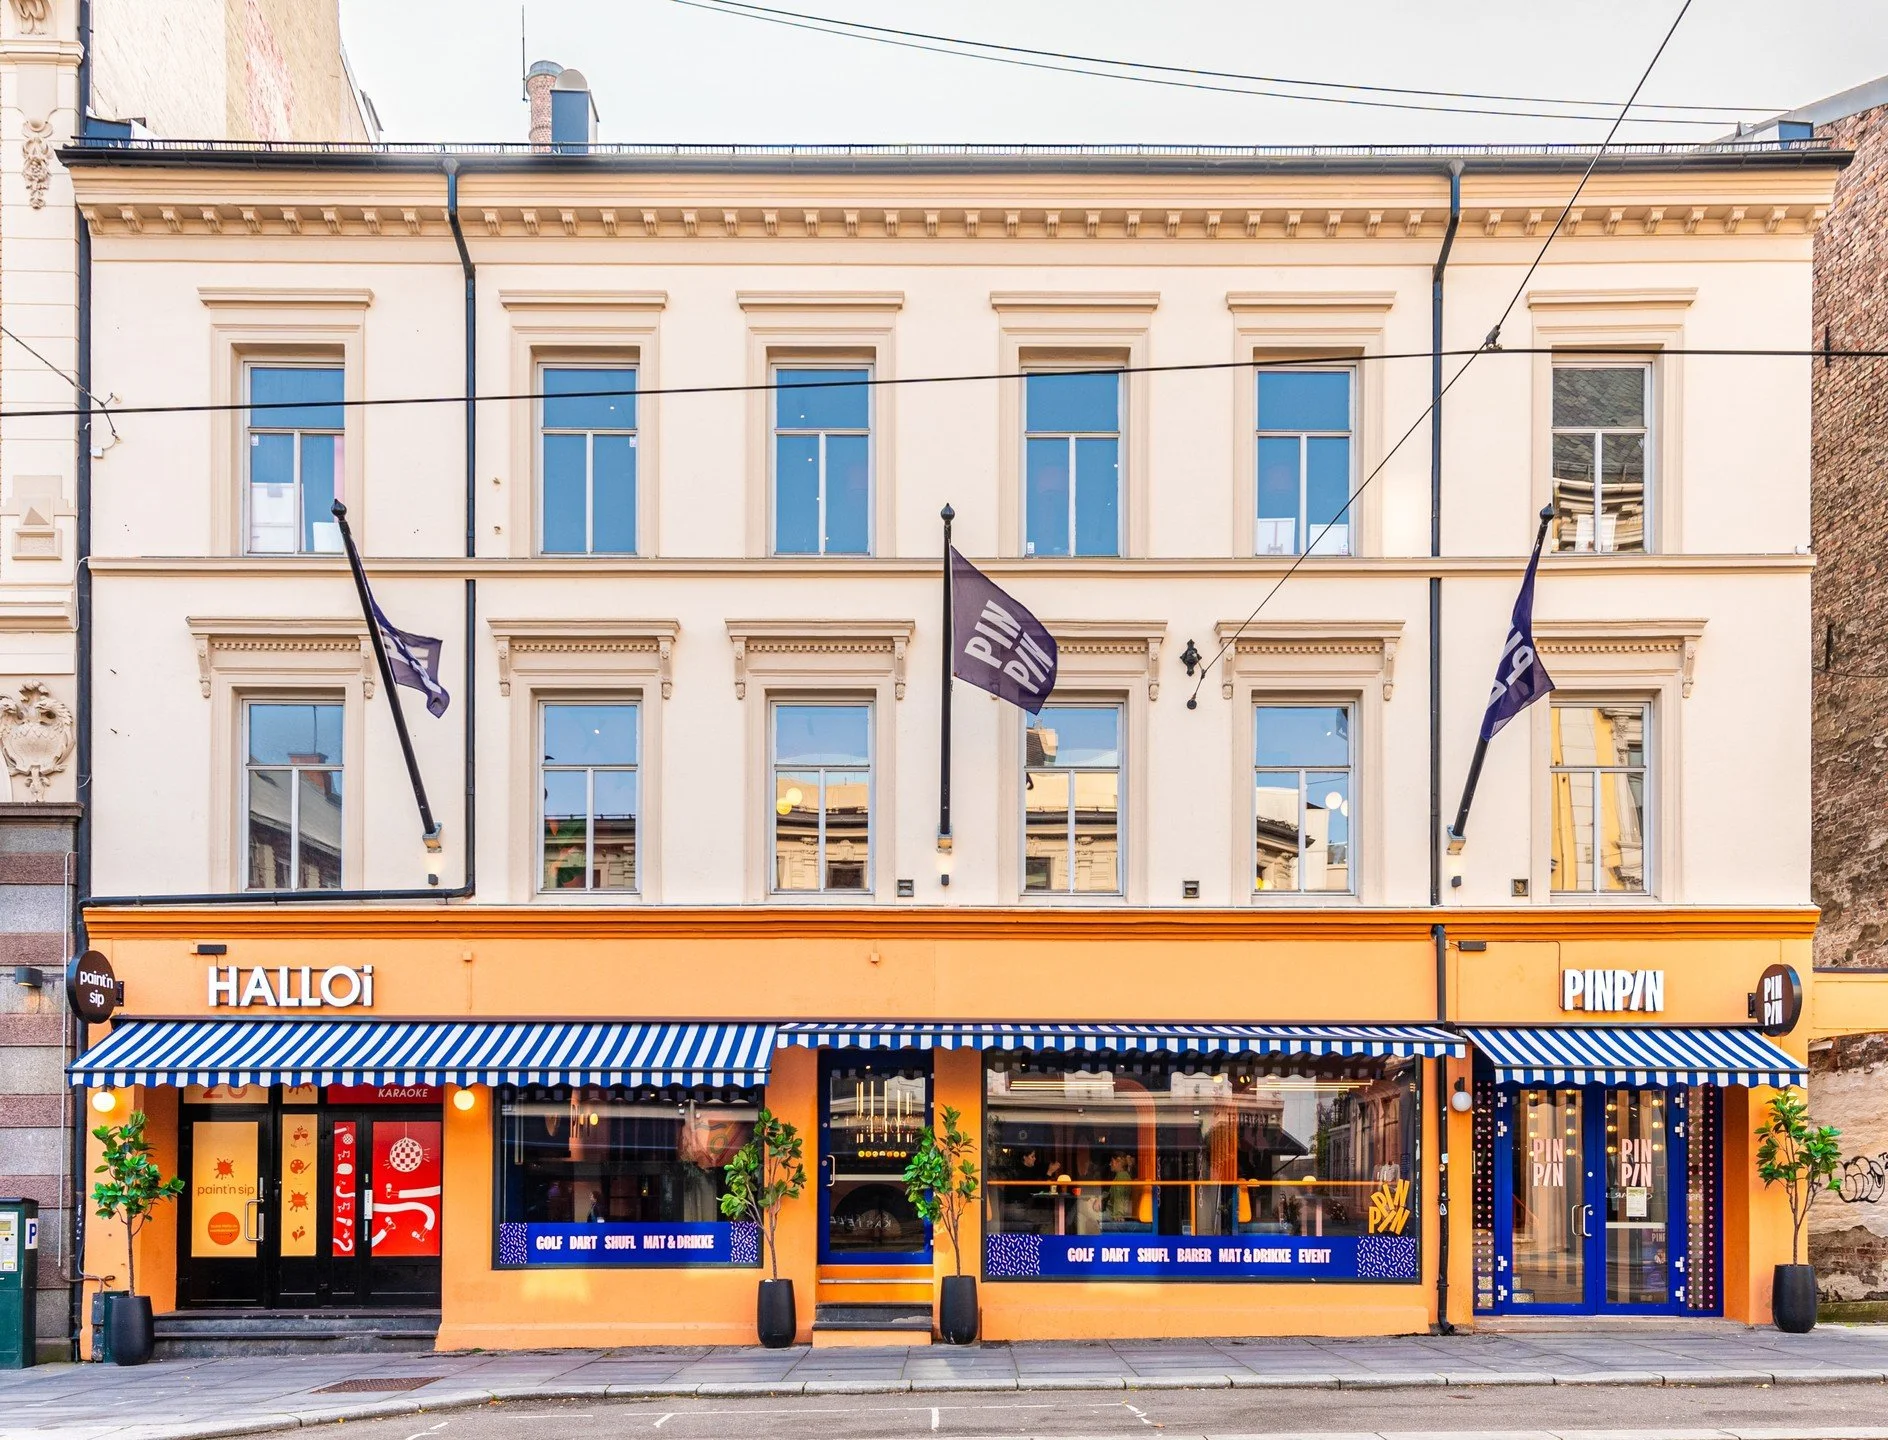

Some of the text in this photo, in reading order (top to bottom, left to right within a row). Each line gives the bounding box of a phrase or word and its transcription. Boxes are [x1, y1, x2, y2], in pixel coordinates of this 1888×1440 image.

[964, 600, 1021, 669] PIN
[1003, 632, 1055, 695] PIN
[80, 970, 114, 989] paint'n
[1764, 975, 1783, 1001] PIN
[89, 989, 105, 1007] sip
[378, 1088, 428, 1098] KARAOKE
[1533, 1138, 1563, 1162] PIN
[1621, 1138, 1652, 1162] PIN
[197, 1184, 255, 1196] paint'n sip
[1370, 1179, 1410, 1217] PIN
[29, 1223, 37, 1244] P
[536, 1236, 563, 1250] GOLF
[569, 1236, 597, 1250] DART
[604, 1235, 636, 1249] SHUFL
[1067, 1248, 1094, 1262] GOLF
[1101, 1248, 1130, 1262] DART
[1137, 1248, 1170, 1262] SHUFL
[1176, 1248, 1212, 1262] BARER
[1299, 1249, 1331, 1263] EVENT
